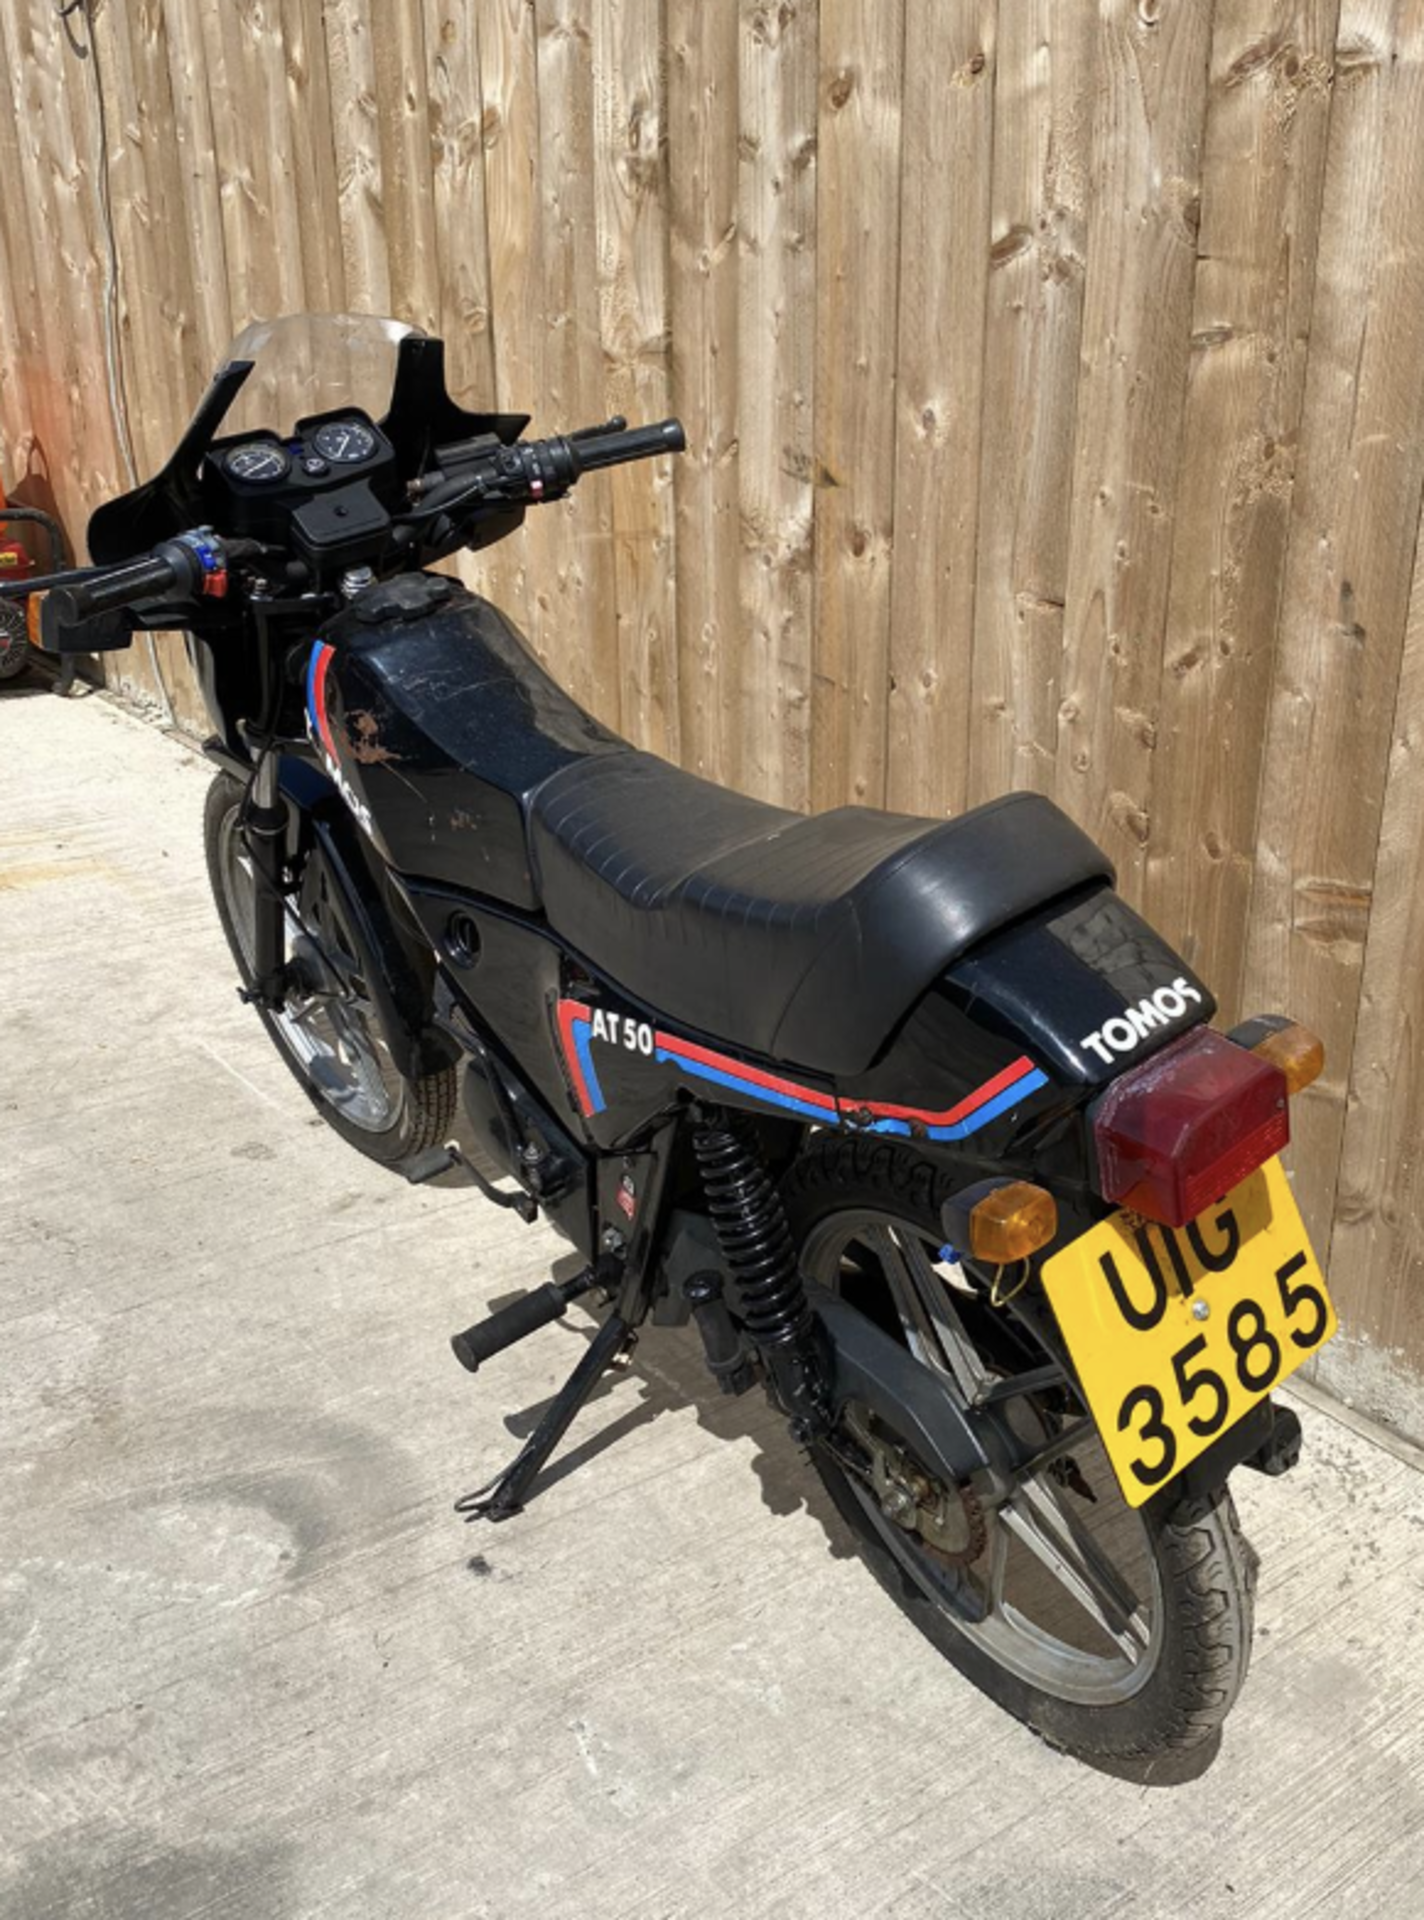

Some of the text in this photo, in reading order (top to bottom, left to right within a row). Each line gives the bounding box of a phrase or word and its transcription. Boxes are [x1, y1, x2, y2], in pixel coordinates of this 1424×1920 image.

[592, 1008, 653, 1056] AT 50
[1080, 977, 1202, 1064] TOMOS
[1117, 1250, 1328, 1487] 3585
